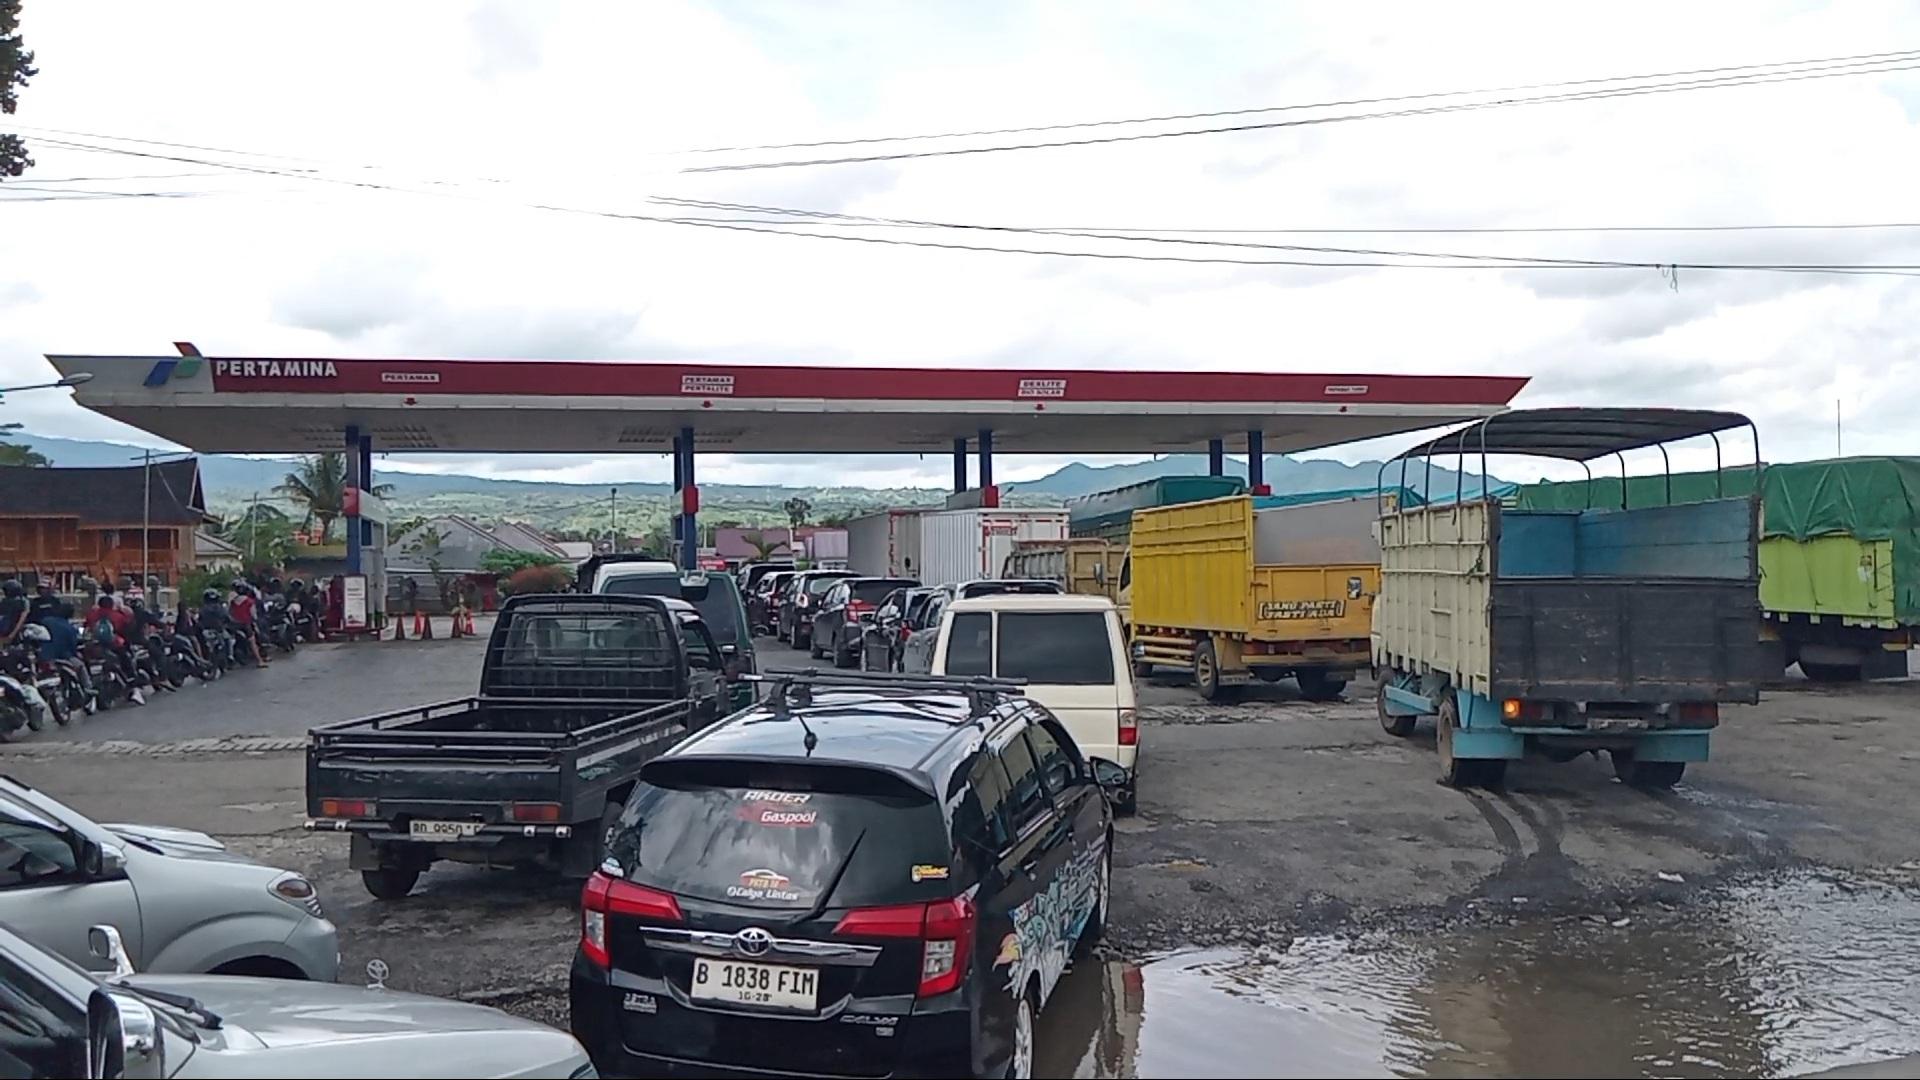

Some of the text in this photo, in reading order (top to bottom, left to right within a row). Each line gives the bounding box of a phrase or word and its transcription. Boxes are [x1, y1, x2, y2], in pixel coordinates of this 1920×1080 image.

[216, 360, 338, 377] PERTAMINA
[761, 811, 816, 824] Gaspool
[696, 963, 814, 996] B 1838 FIM
